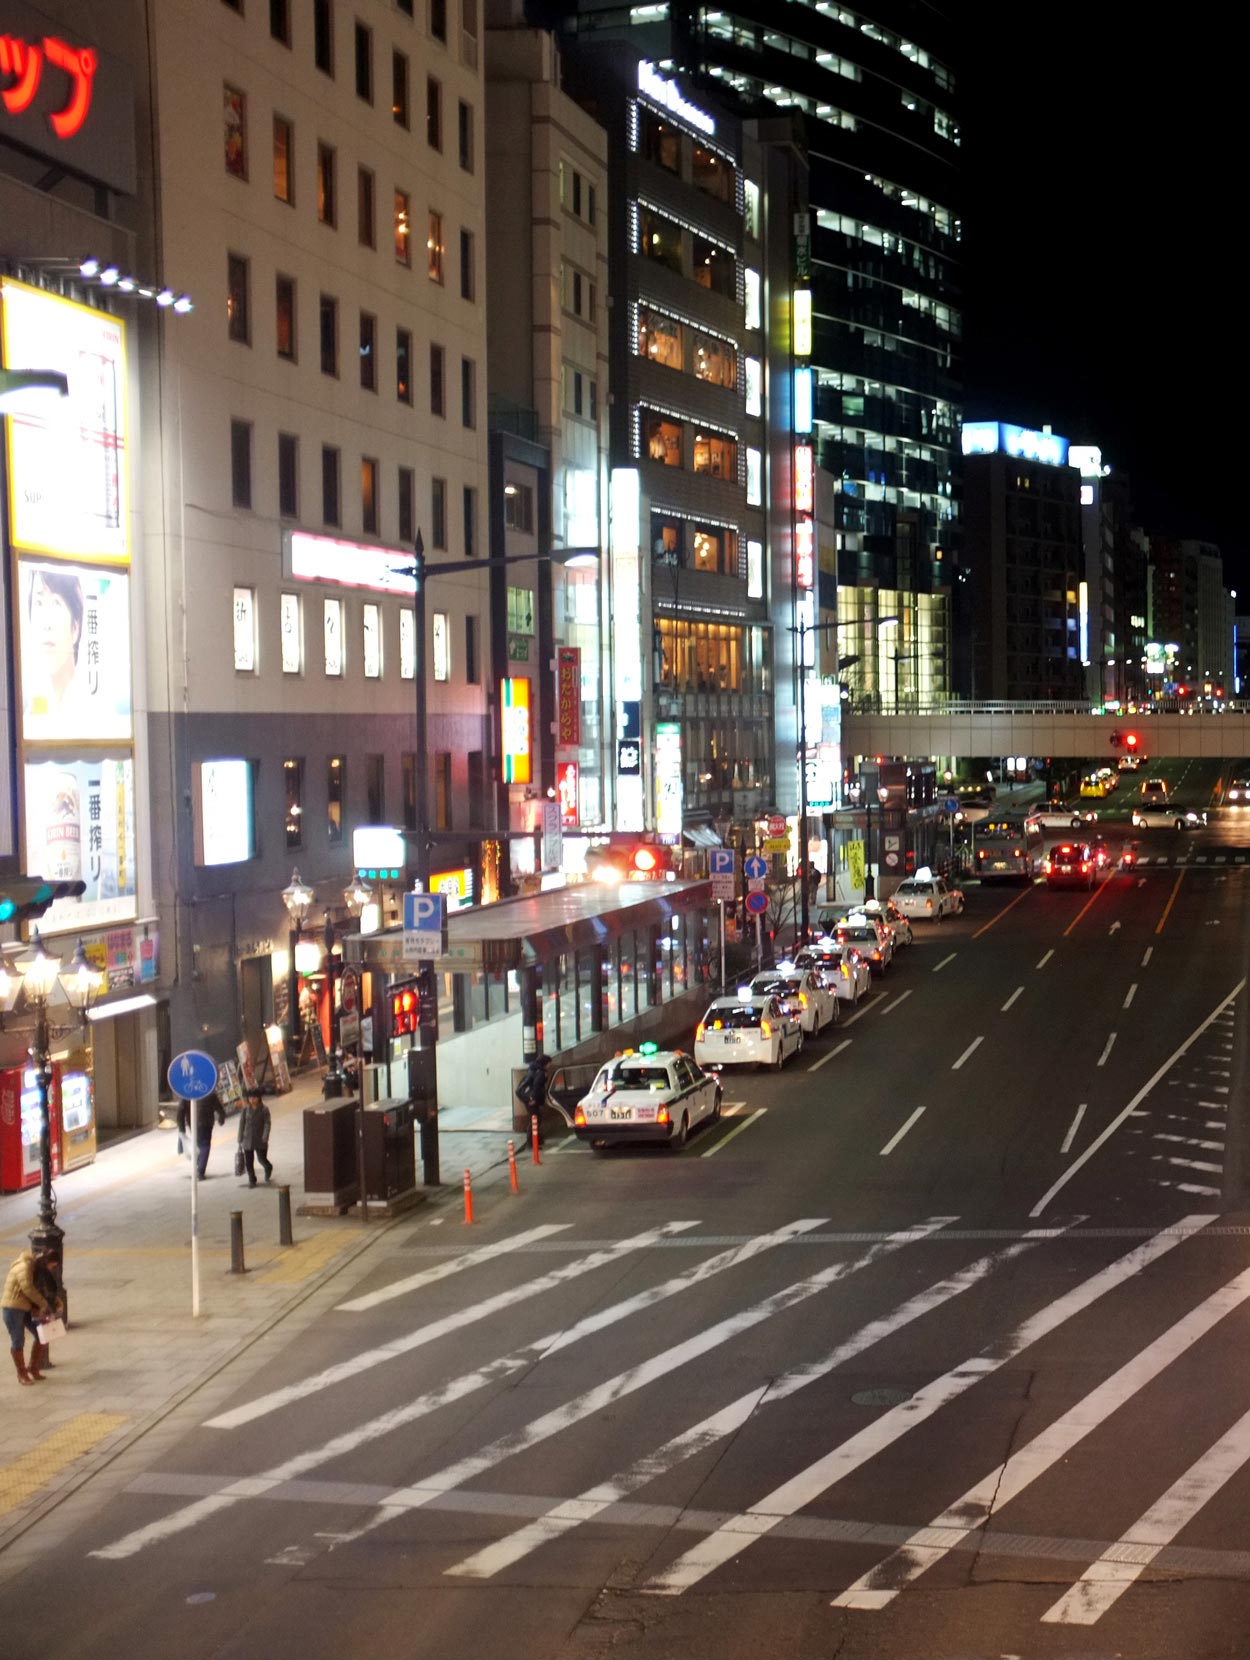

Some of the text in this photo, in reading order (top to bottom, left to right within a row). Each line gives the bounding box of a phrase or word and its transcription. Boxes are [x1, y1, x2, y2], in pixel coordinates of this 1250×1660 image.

[86, 594, 100, 696] 一番搾り
[561, 668, 573, 741] おたからや
[87, 779, 102, 883] 一番搾り
[715, 853, 729, 871] P
[413, 897, 435, 927] P
